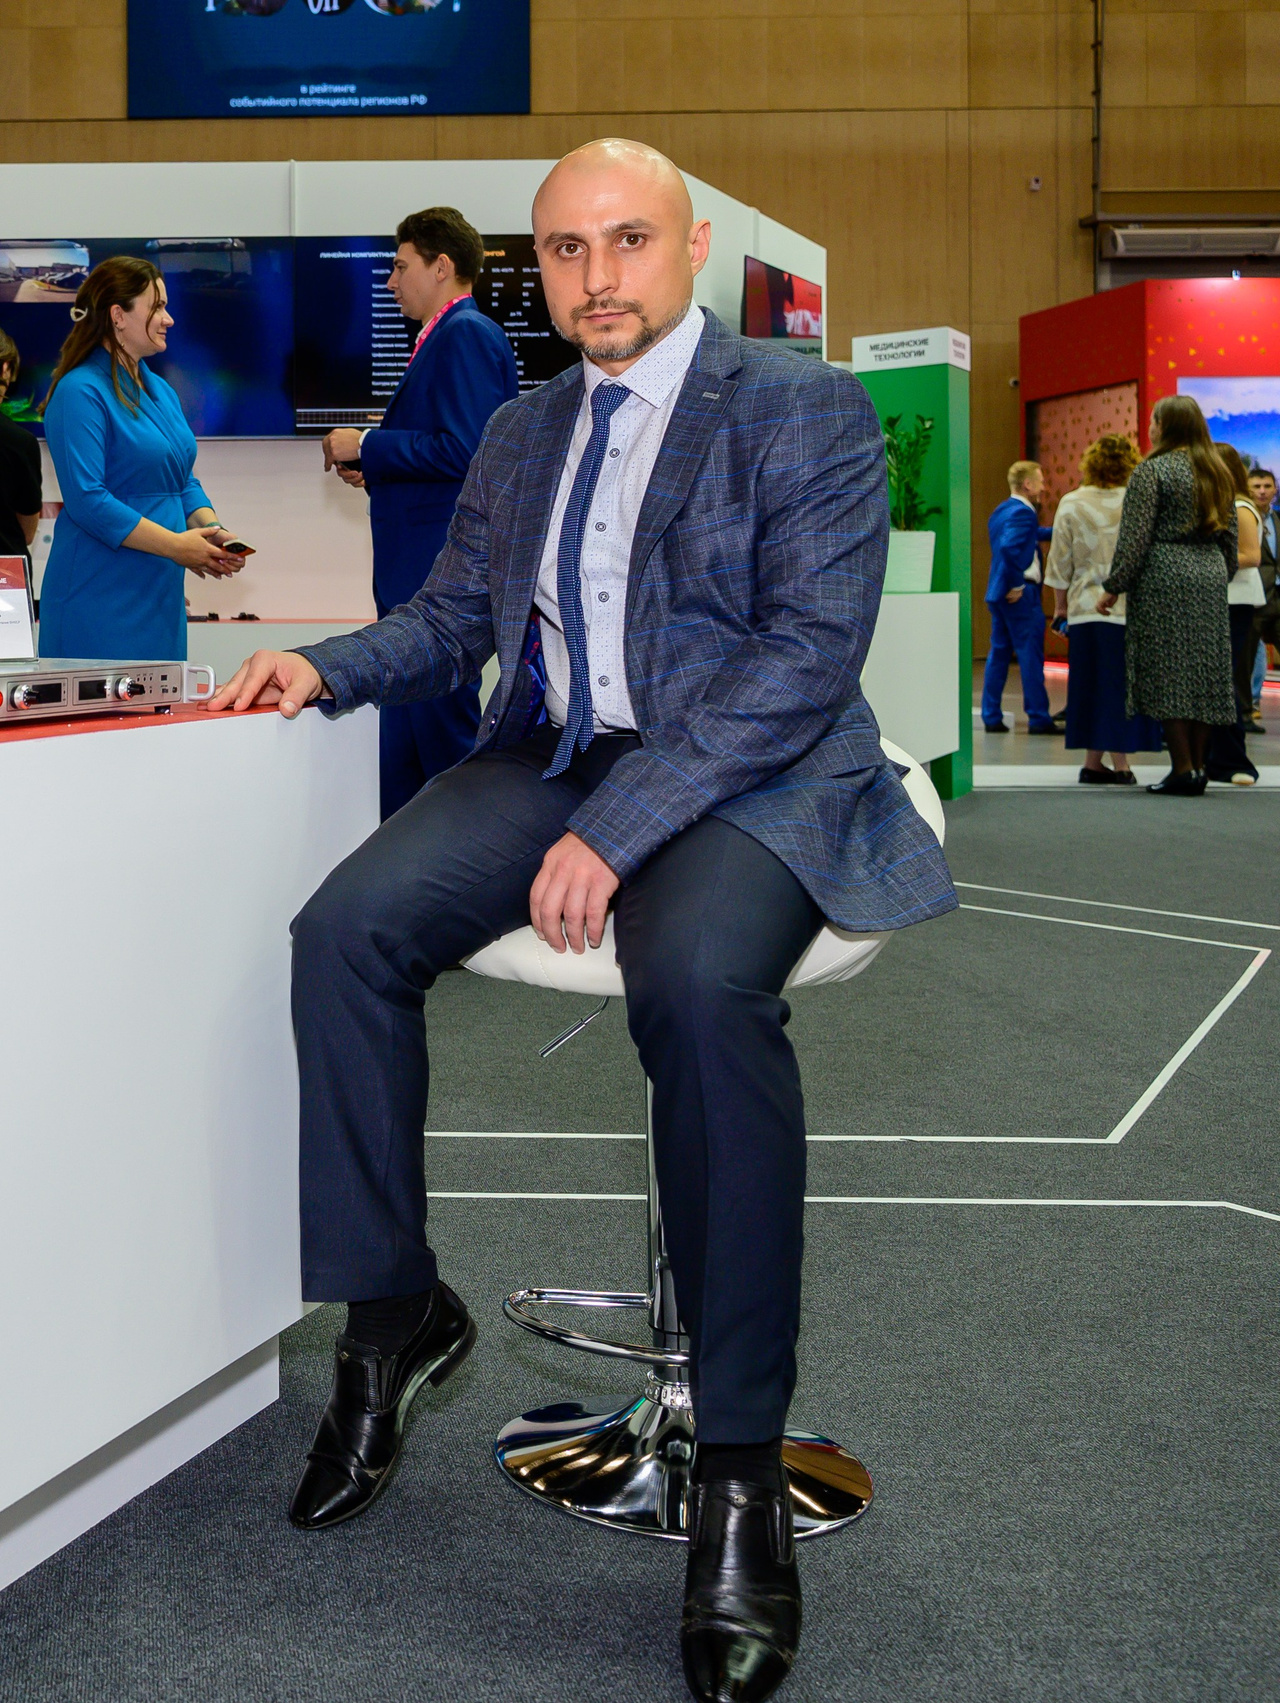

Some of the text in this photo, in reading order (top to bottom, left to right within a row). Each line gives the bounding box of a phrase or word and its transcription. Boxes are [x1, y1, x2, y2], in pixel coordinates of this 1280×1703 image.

[309, 83, 356, 95] рейтинге
[229, 94, 428, 107] событийного потенциала регионов РФ
[869, 338, 929, 351] МЕДИЦИНСКИЕ
[874, 350, 926, 362] ТЕХНОЛОГИИ
